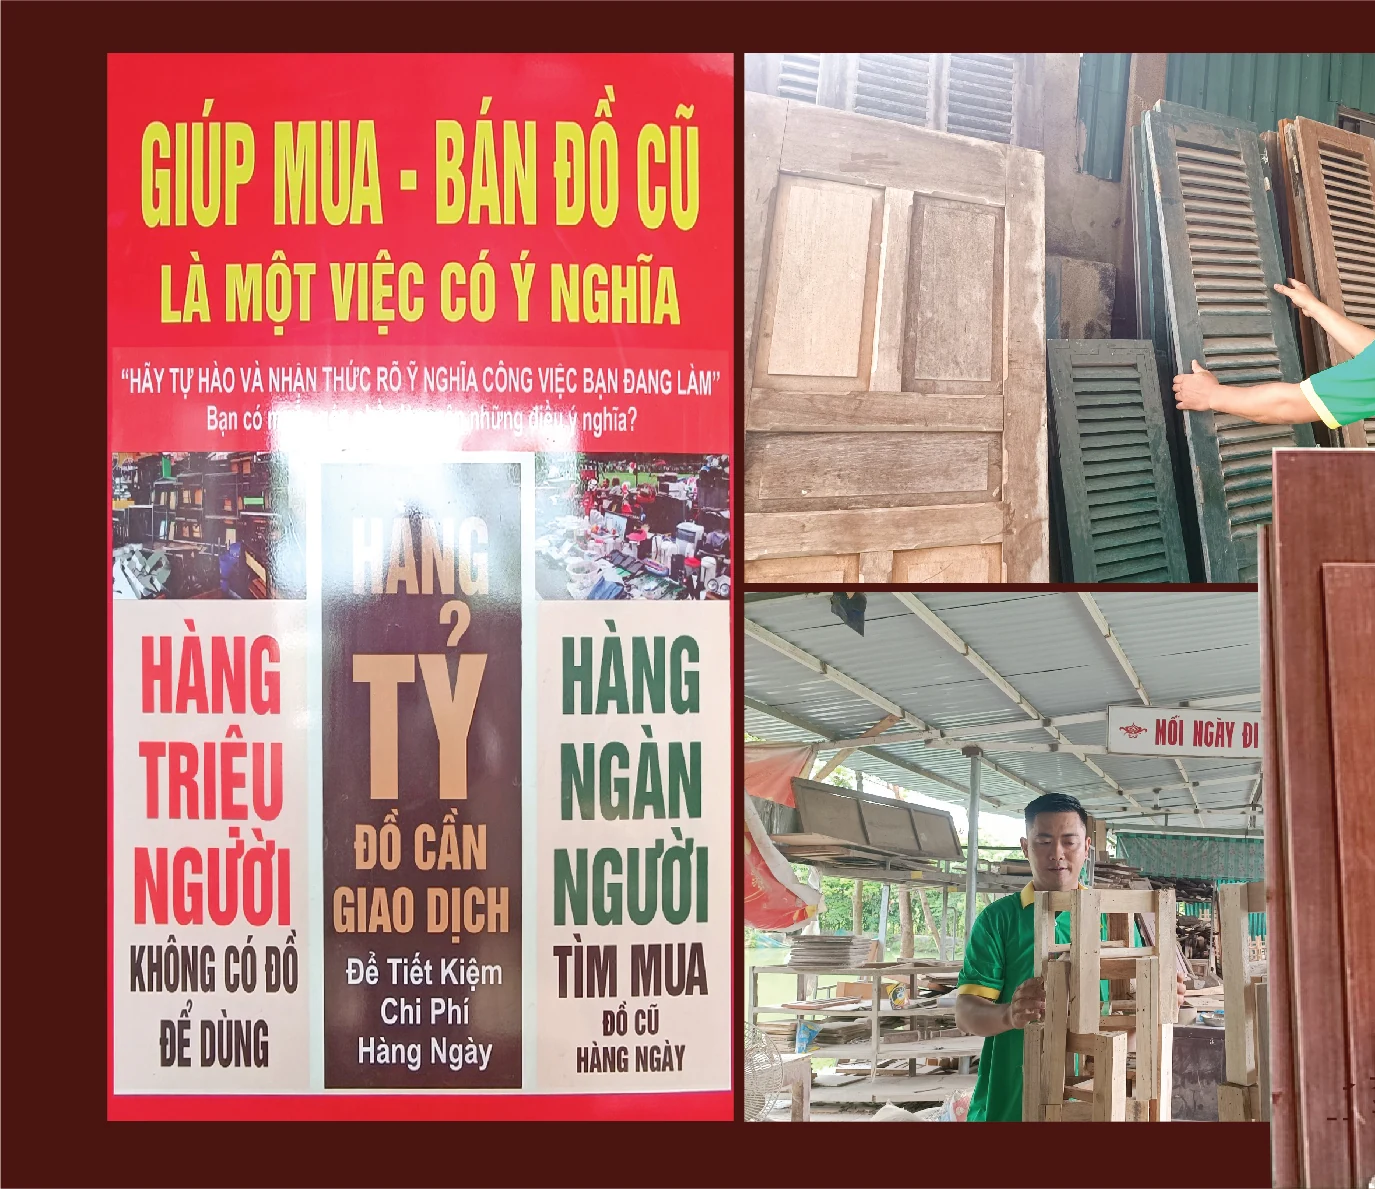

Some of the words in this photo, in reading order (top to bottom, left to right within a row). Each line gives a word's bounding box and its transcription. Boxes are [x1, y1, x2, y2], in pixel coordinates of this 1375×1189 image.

[141, 97, 255, 229] GIÚP
[272, 118, 384, 226] MUA
[434, 96, 537, 226] BÁN
[553, 84, 620, 228] ĐỒ
[636, 103, 700, 230] CŨ
[160, 251, 210, 323] LÀ
[224, 250, 316, 336] MỘT
[330, 250, 425, 335] VIỆC
[440, 249, 497, 323] CÓ
[510, 249, 536, 323] Ý
[550, 253, 682, 325] NGHĨA
[121, 361, 163, 393] “HÃY
[169, 366, 194, 399] TỰ
[200, 360, 235, 393] HÀO
[240, 360, 264, 393] VÀ
[322, 359, 371, 393] THỨC
[377, 360, 401, 392] RÕ
[424, 360, 479, 393] NGHĨA
[482, 360, 533, 393] CÔNG
[538, 363, 578, 399] VIỆC
[583, 367, 618, 400] BẠN
[623, 368, 672, 396] ĐANG
[678, 363, 721, 397] LÀM”
[207, 405, 237, 437] Bạn
[243, 404, 263, 430] có
[471, 403, 523, 438] những
[583, 405, 638, 438] nghĩa?
[141, 619, 281, 715] HÀNG
[561, 619, 700, 715] HÀNG
[352, 600, 488, 801] TỶ
[1193, 717, 1235, 748] NGÀY
[138, 724, 283, 838] TRIỆU
[560, 724, 702, 821] NGÀN
[354, 808, 402, 870] ĐỒ
[413, 808, 488, 870] CẦN
[134, 828, 291, 926] NGƯỜI
[553, 826, 709, 926] NGƯỜI
[333, 886, 415, 934] GIAO
[427, 886, 510, 944] DỊCH
[130, 934, 216, 993] KHÔNG
[224, 934, 257, 993] CÓ
[264, 929, 299, 993] ĐỒ
[346, 952, 378, 986] Để
[386, 952, 433, 986] Tiết
[440, 956, 503, 993] Kiệm
[553, 933, 618, 999] TÌM
[630, 942, 709, 996] MUA
[159, 1000, 192, 1069] ĐỂ
[200, 1010, 270, 1069] DÙNG
[380, 996, 421, 1025] Chi
[430, 996, 470, 1026] Phí
[602, 1001, 628, 1036] ĐỒ
[634, 1005, 660, 1036] CŨ
[357, 1035, 421, 1071] Hàng
[430, 1037, 493, 1071] Ngày
[576, 1039, 629, 1073] HÀNG
[635, 1039, 686, 1073] NGÀY
